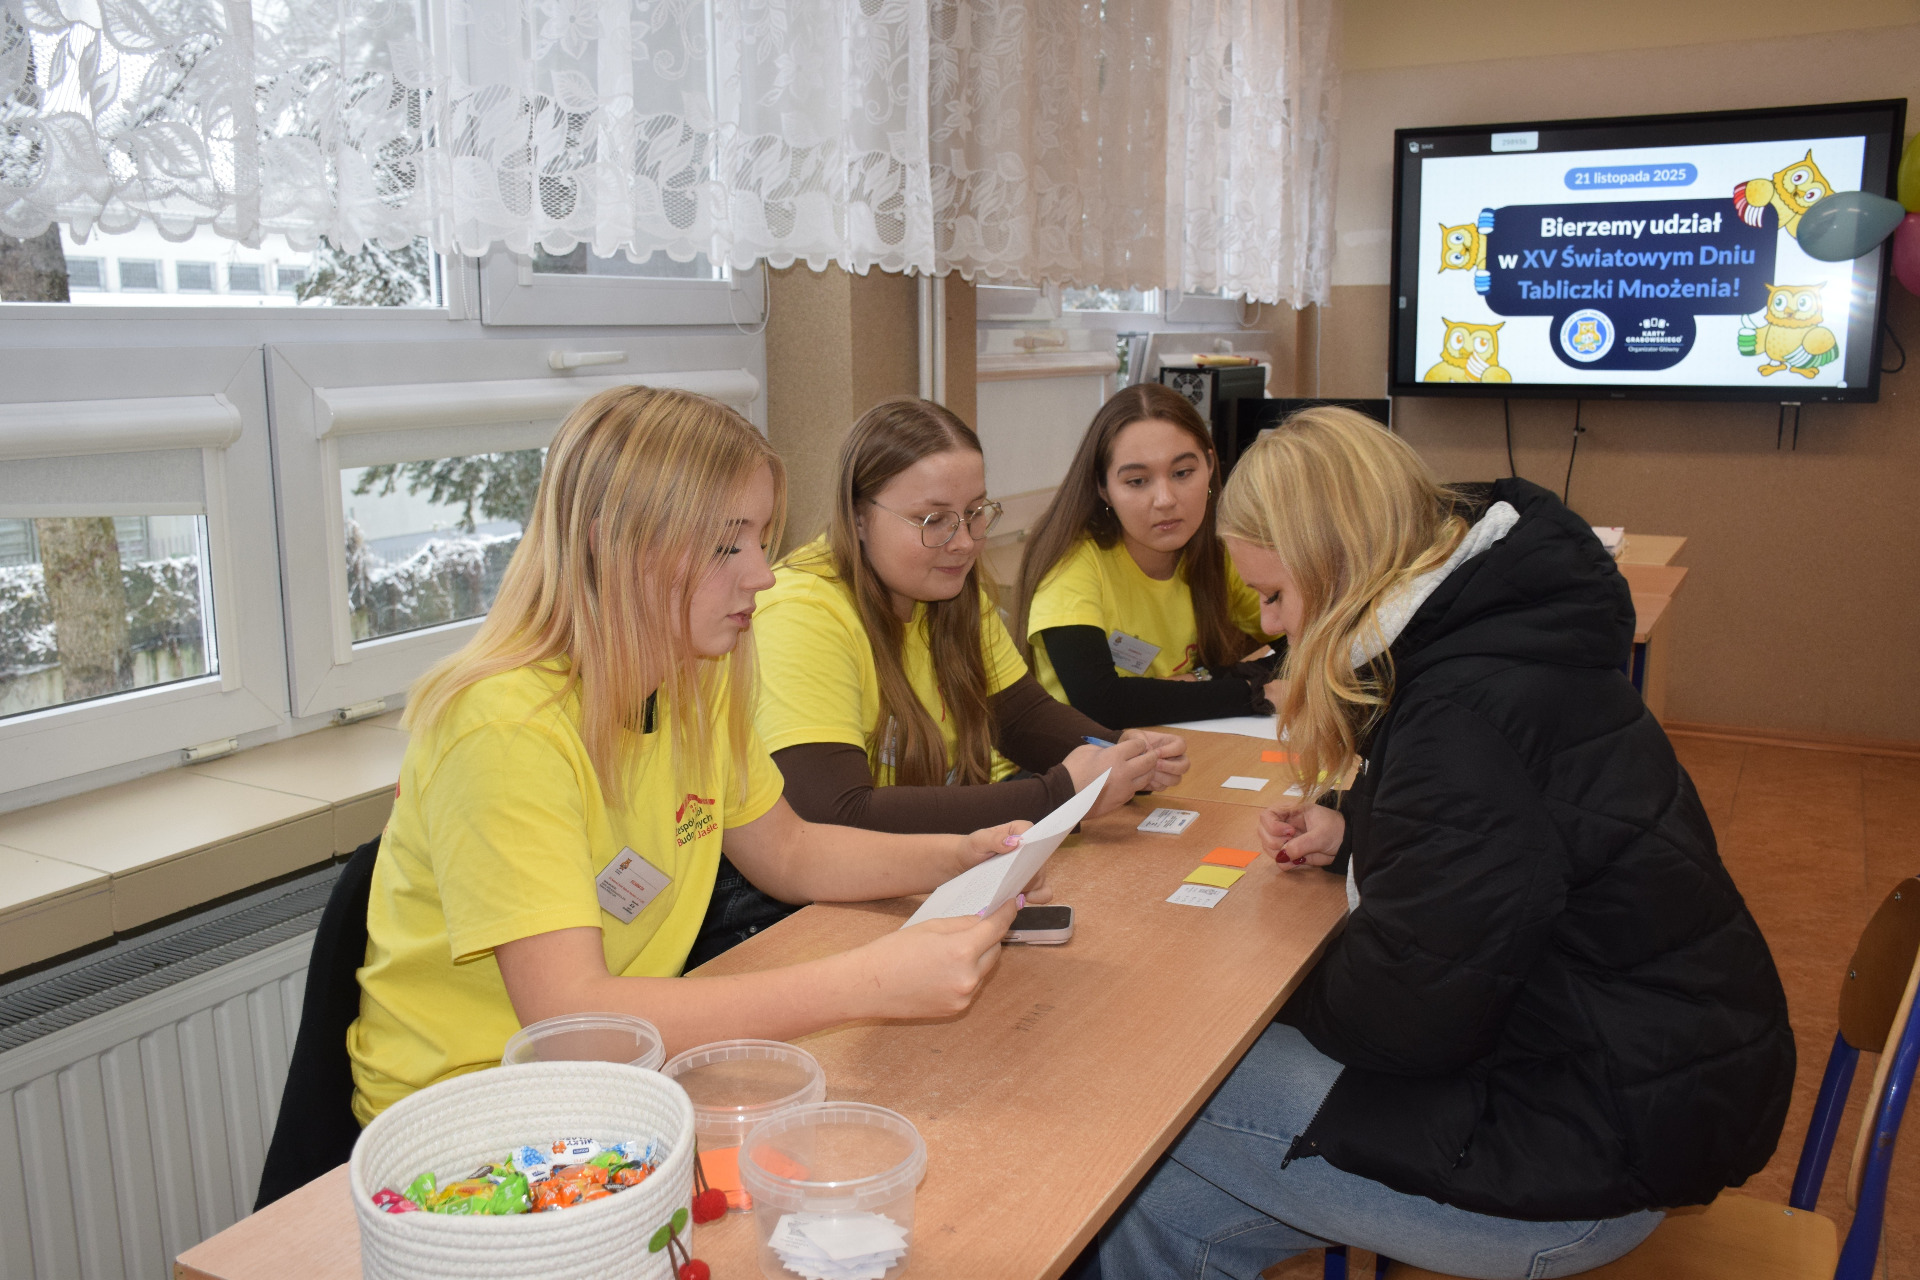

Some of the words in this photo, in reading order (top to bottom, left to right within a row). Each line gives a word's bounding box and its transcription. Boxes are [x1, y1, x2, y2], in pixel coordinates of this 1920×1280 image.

[1574, 173, 1591, 185] 21
[1593, 171, 1650, 186] listopada
[1653, 168, 1687, 182] 2025
[1540, 216, 1646, 240] Bierzemy
[1649, 212, 1723, 235] udział
[1498, 254, 1519, 270] w
[1522, 249, 1558, 269] XV
[1560, 245, 1694, 271] Światowym
[1699, 244, 1756, 267] Dniu
[1517, 278, 1614, 300] Tabliczki
[1618, 277, 1741, 299] Mnożenia!
